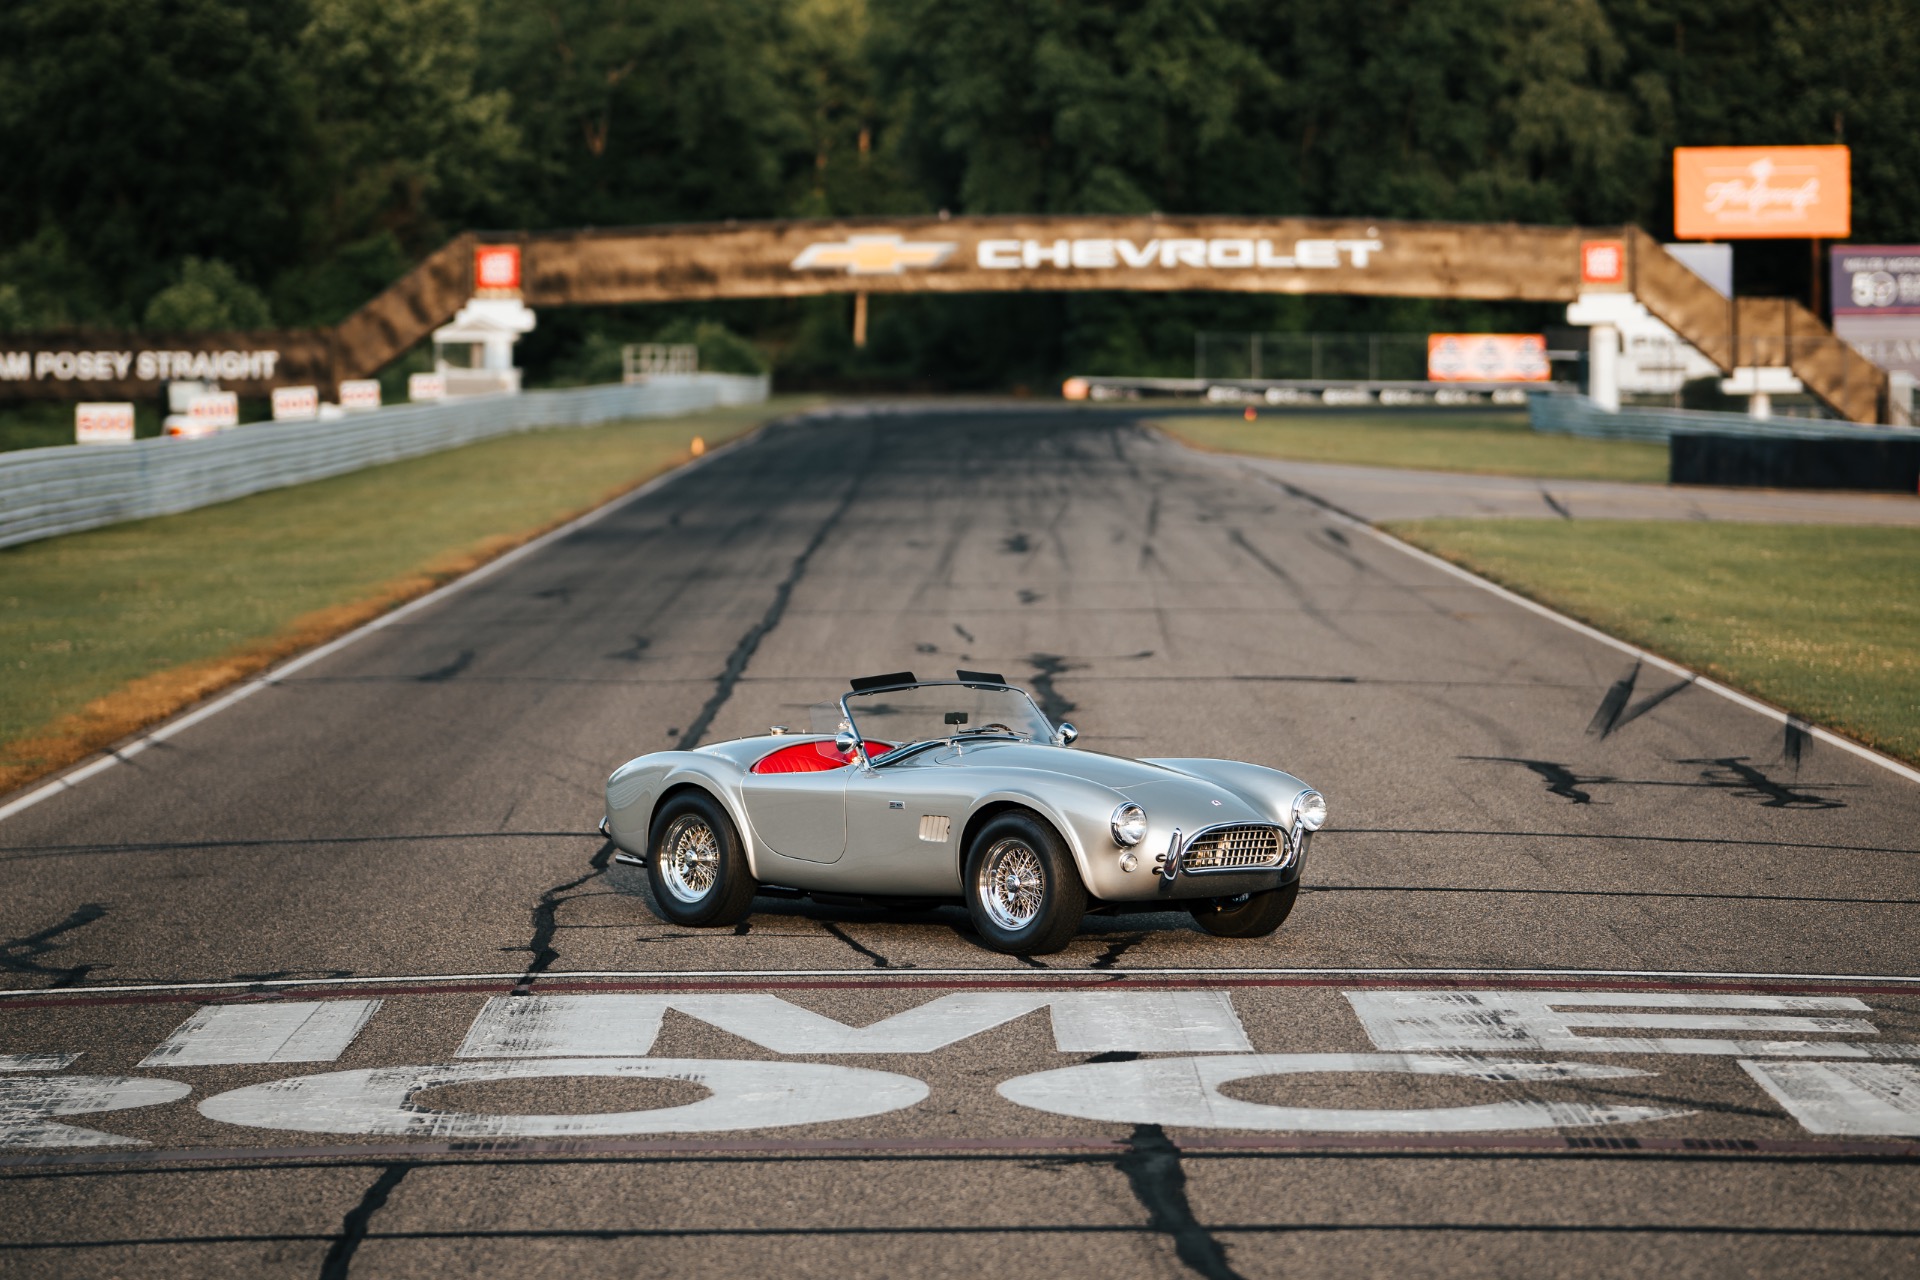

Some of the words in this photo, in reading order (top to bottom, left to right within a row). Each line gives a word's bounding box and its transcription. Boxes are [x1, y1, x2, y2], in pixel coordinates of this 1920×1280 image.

[976, 237, 1381, 268] CHEVROLET
[35, 350, 132, 380] POSEY
[136, 350, 279, 380] STRAIGHT
